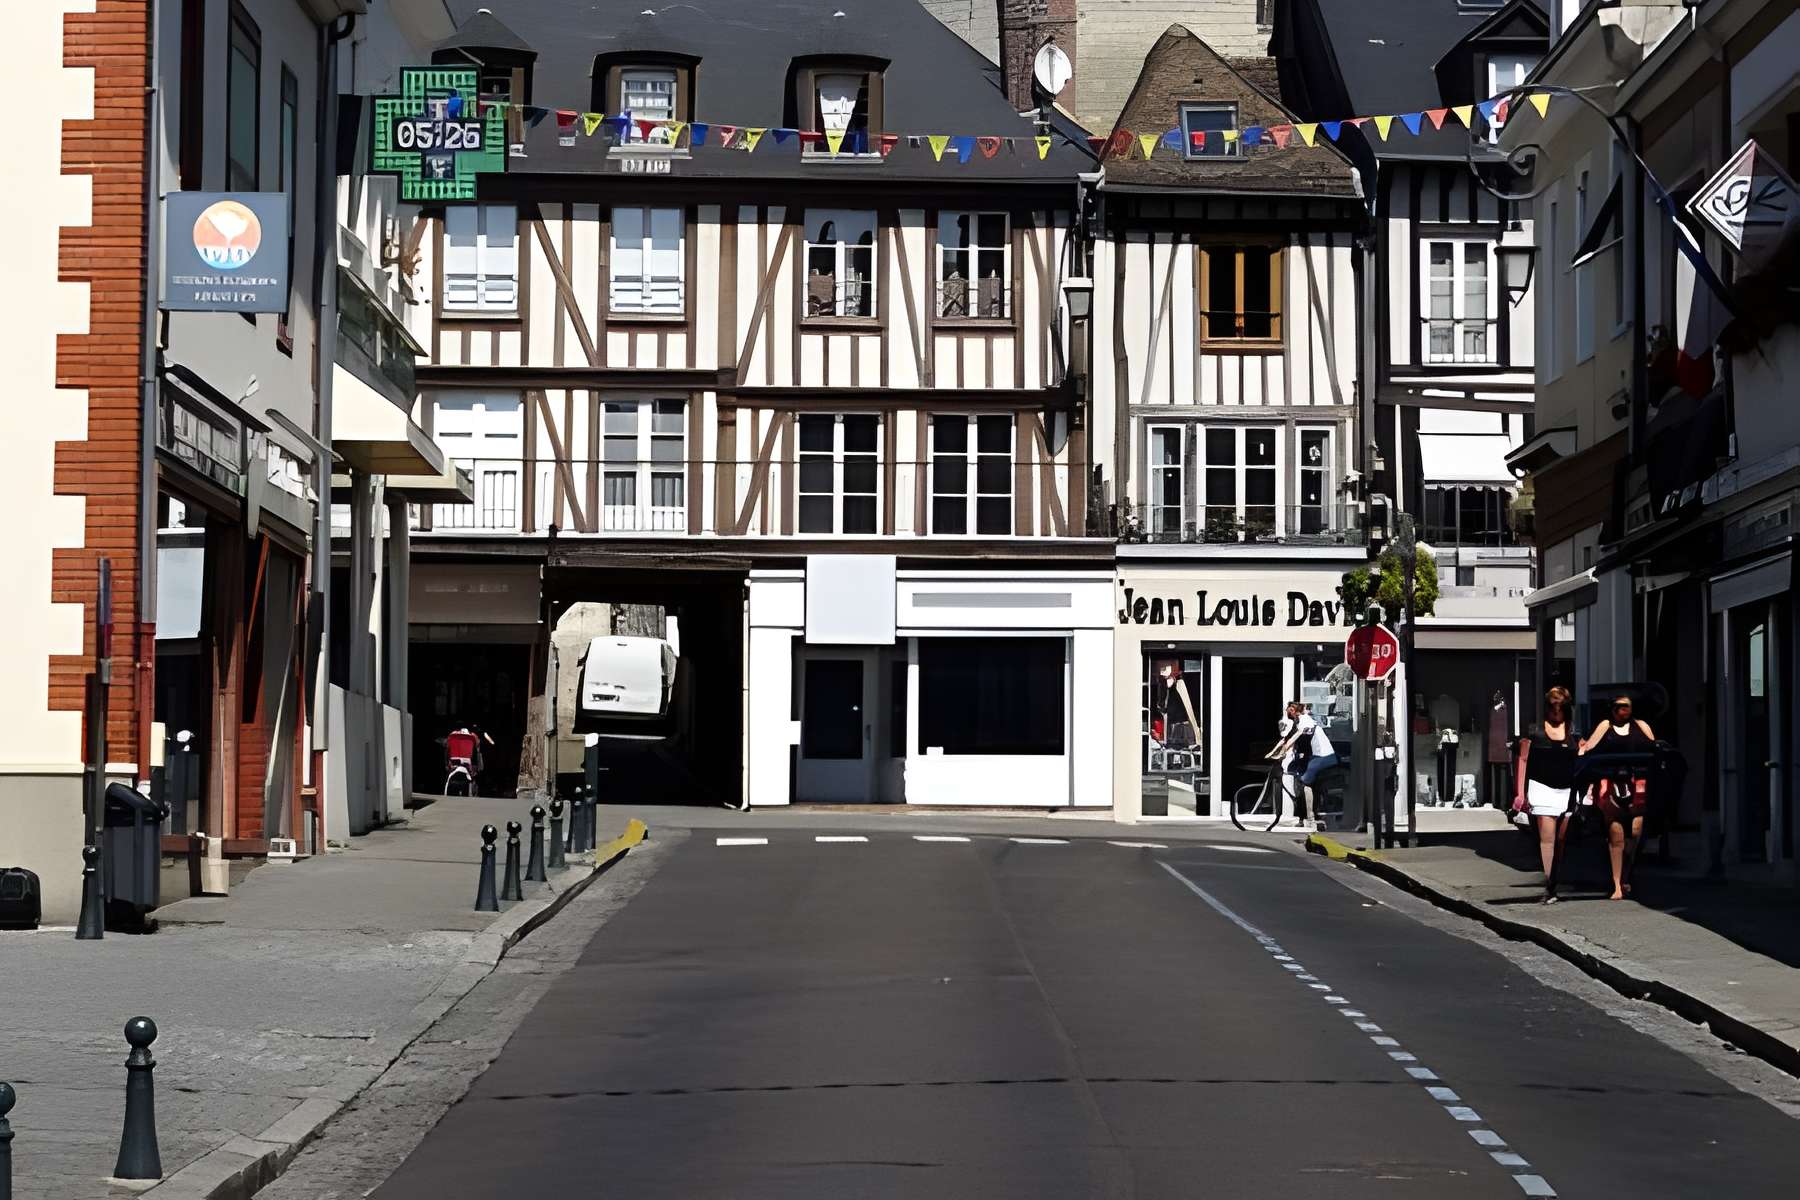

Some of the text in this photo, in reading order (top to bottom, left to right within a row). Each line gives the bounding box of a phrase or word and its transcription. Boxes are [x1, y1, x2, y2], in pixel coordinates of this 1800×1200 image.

[1119, 579, 1353, 626] Jean Louis Dav
